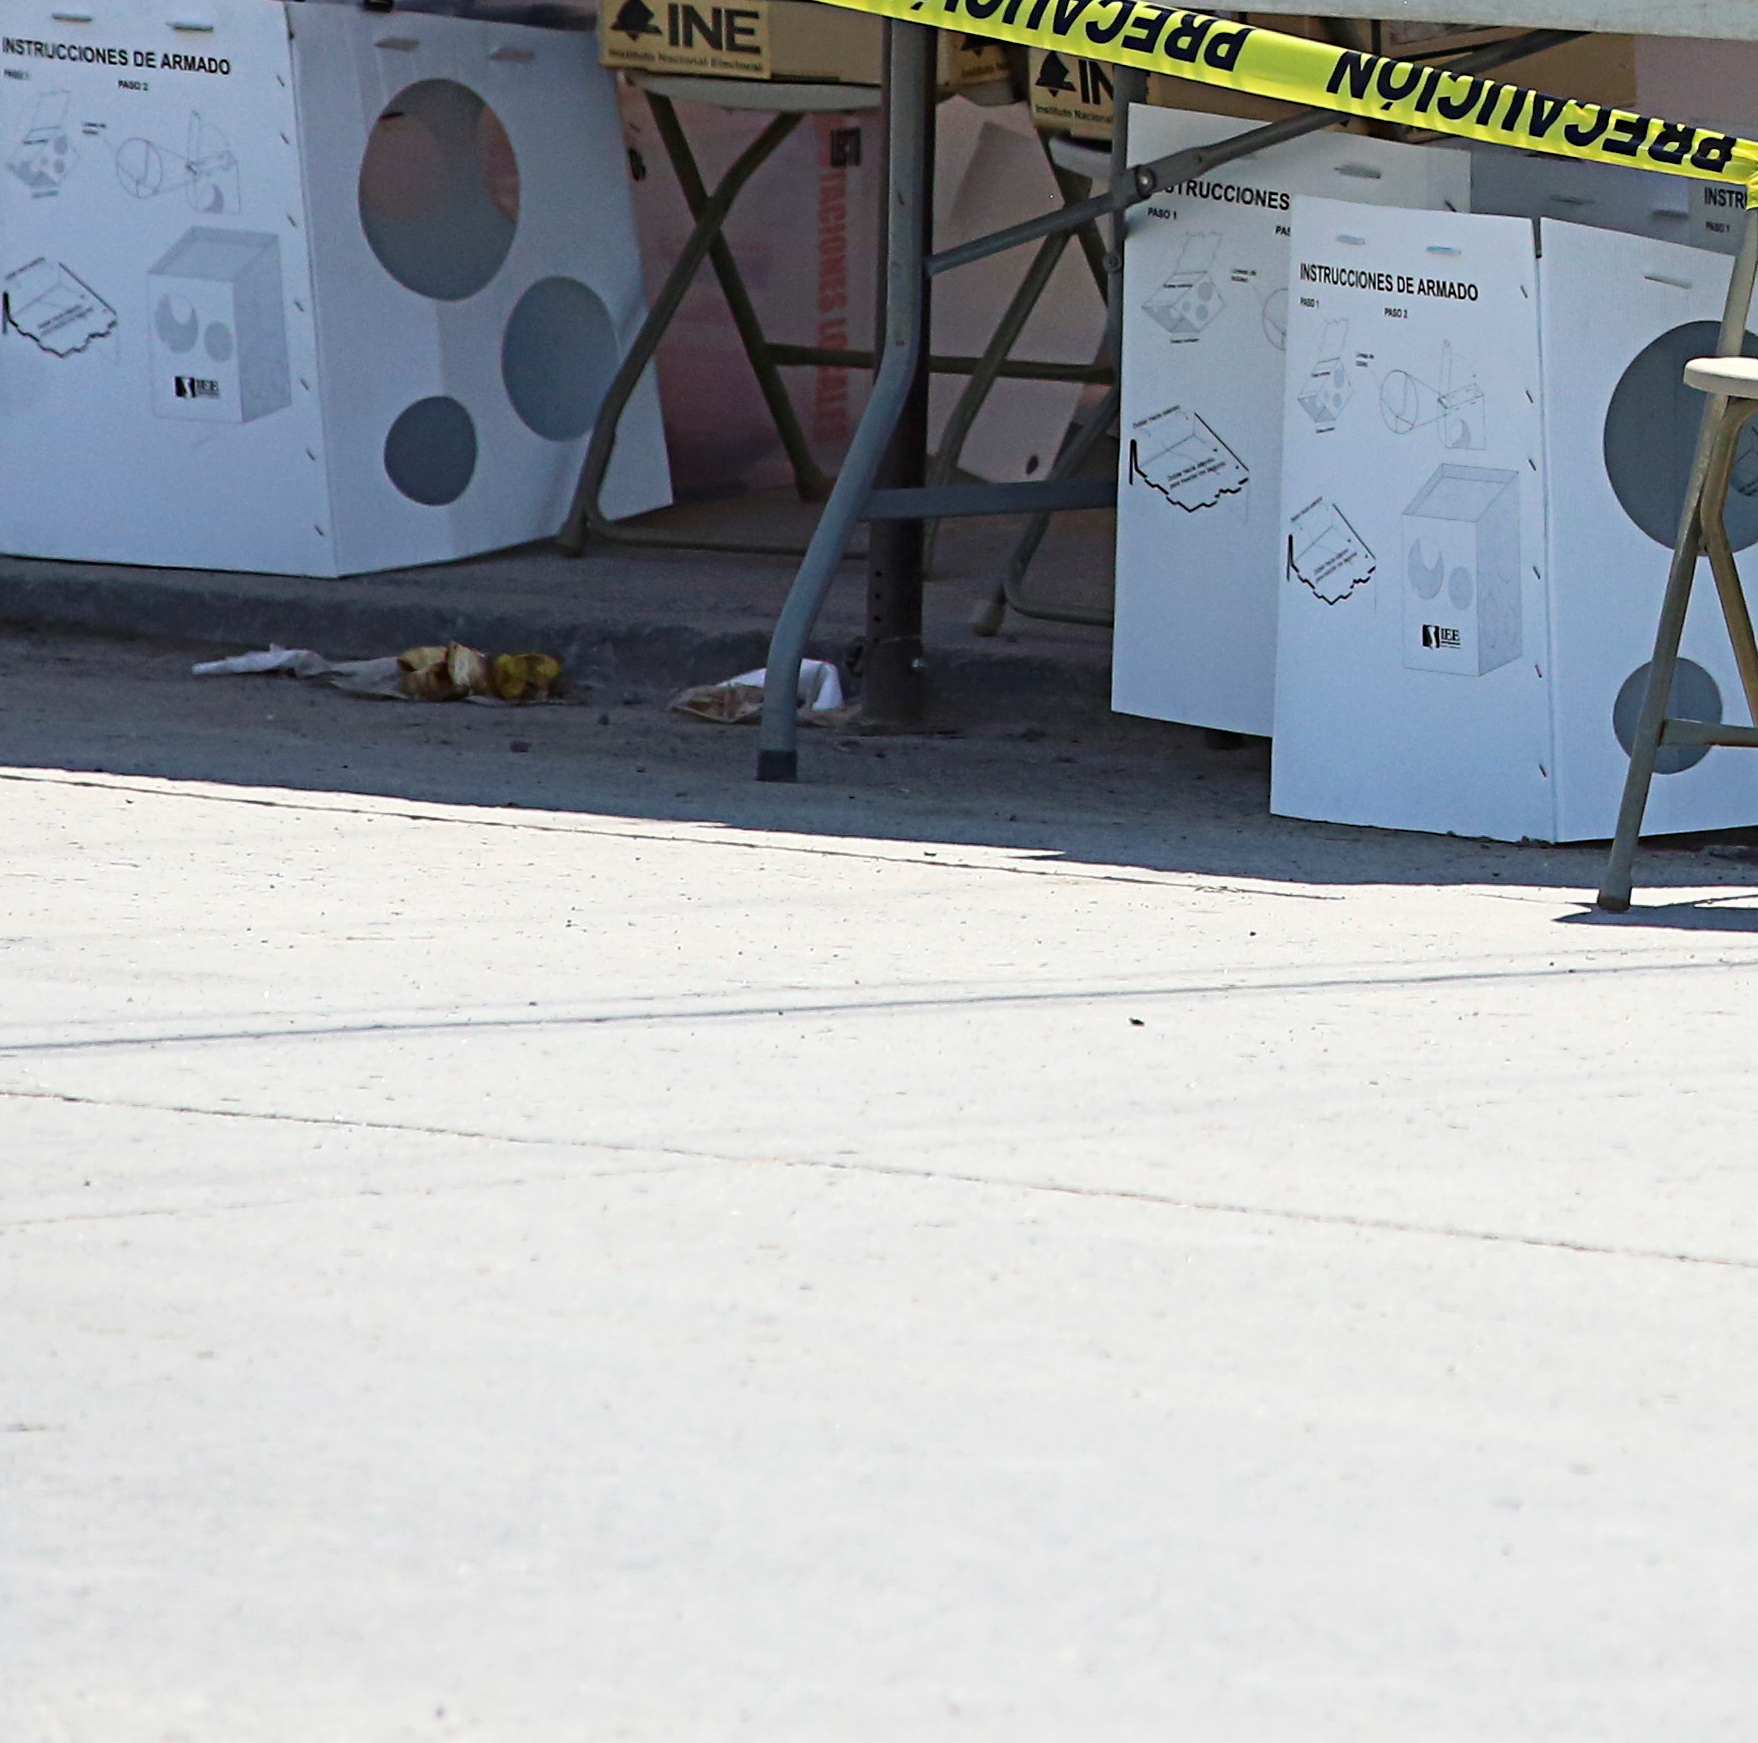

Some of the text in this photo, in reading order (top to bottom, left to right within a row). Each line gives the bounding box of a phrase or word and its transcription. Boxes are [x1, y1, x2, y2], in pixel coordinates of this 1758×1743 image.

[667, 2, 762, 55] INE
[2, 36, 231, 75] INSTRUCCIONES DE ARMADO
[117, 79, 141, 91] PASO
[1326, 50, 1737, 173] PRECAUCIÓN
[1147, 207, 1169, 220] PASO
[1705, 221, 1725, 234] PASO
[1300, 262, 1479, 302] INSTRUCCIONES DE ARMADO
[1300, 296, 1316, 309] PASO
[1384, 307, 1403, 319] PASO
[1440, 627, 1460, 642] IEE
